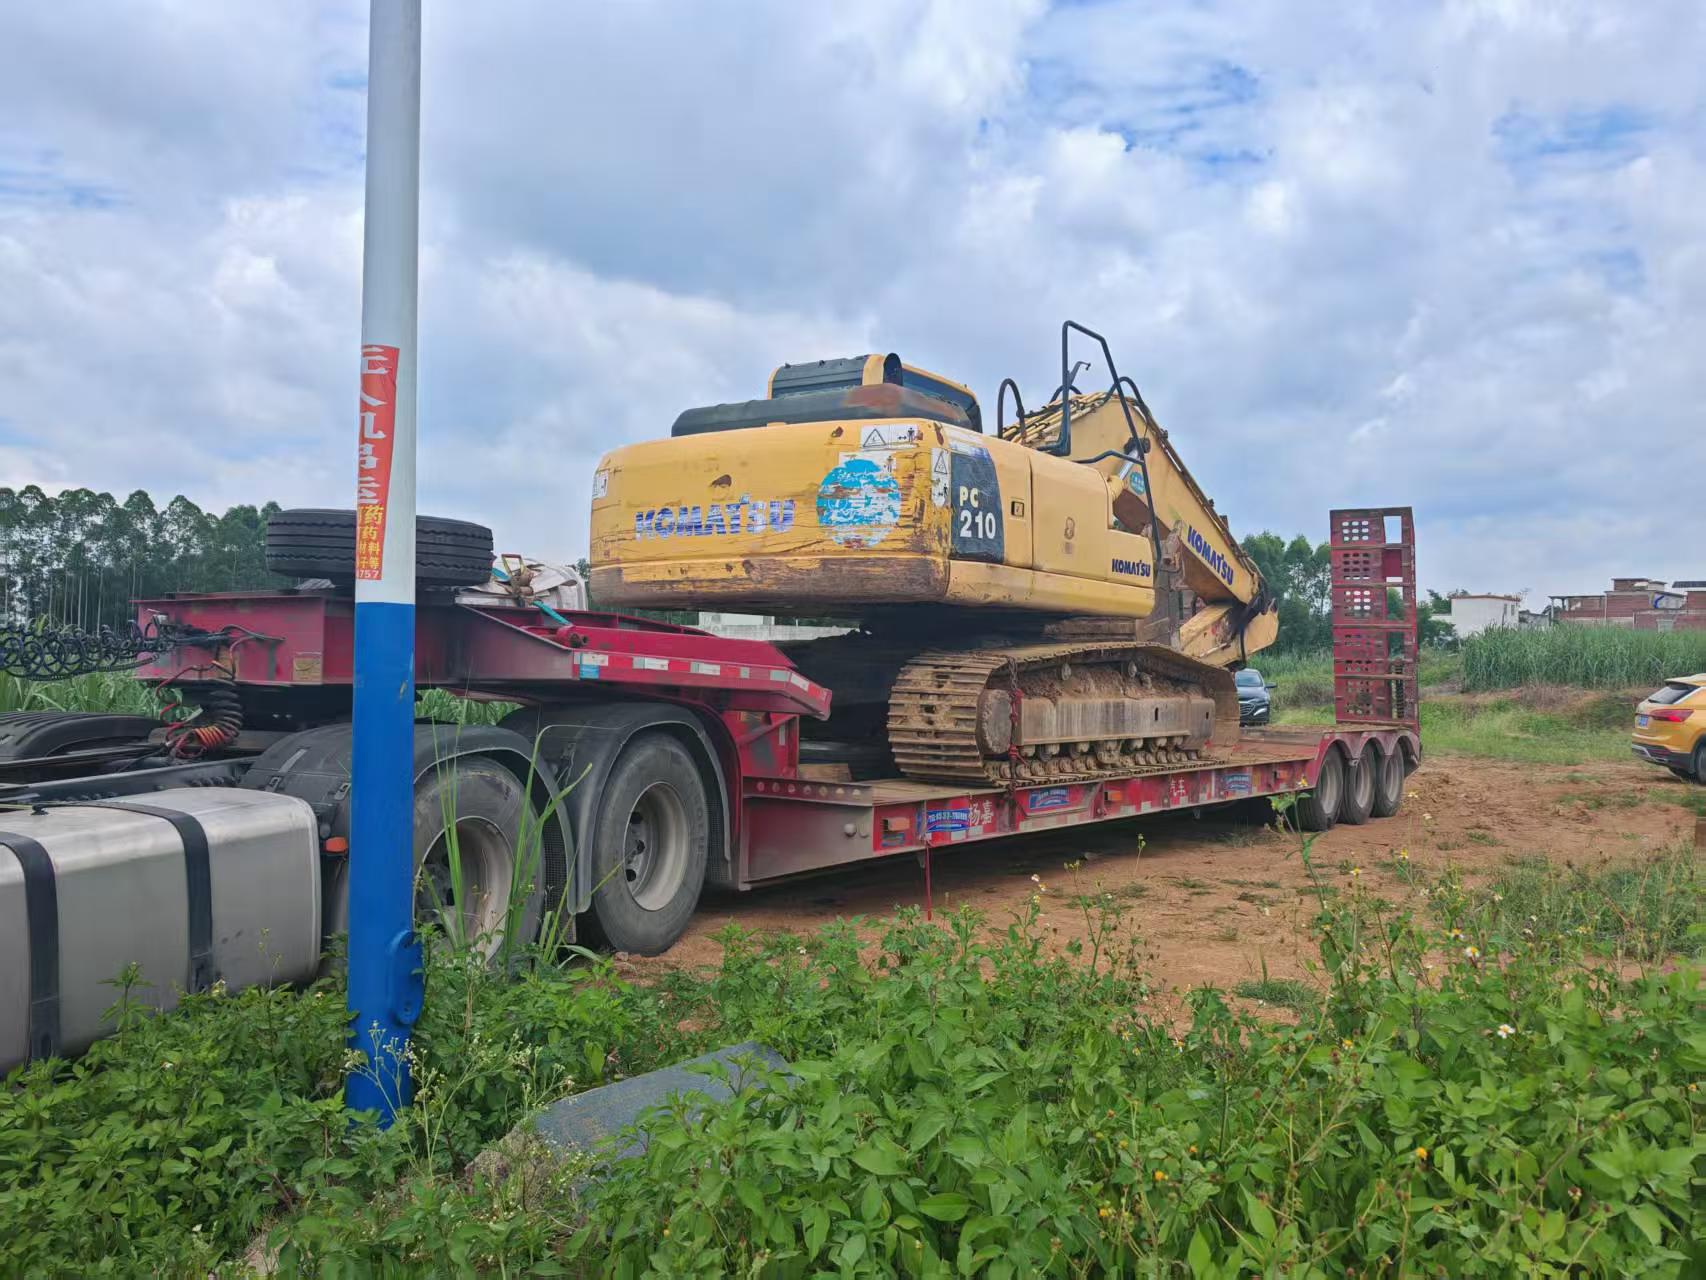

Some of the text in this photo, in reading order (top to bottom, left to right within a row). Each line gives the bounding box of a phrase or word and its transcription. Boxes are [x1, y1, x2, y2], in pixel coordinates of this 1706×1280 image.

[960, 486, 978, 507] PC
[635, 493, 795, 541] KOMATSU
[960, 510, 996, 539] 210
[1112, 558, 1150, 577] KOMATSU
[1187, 525, 1234, 585] KOMATSU
